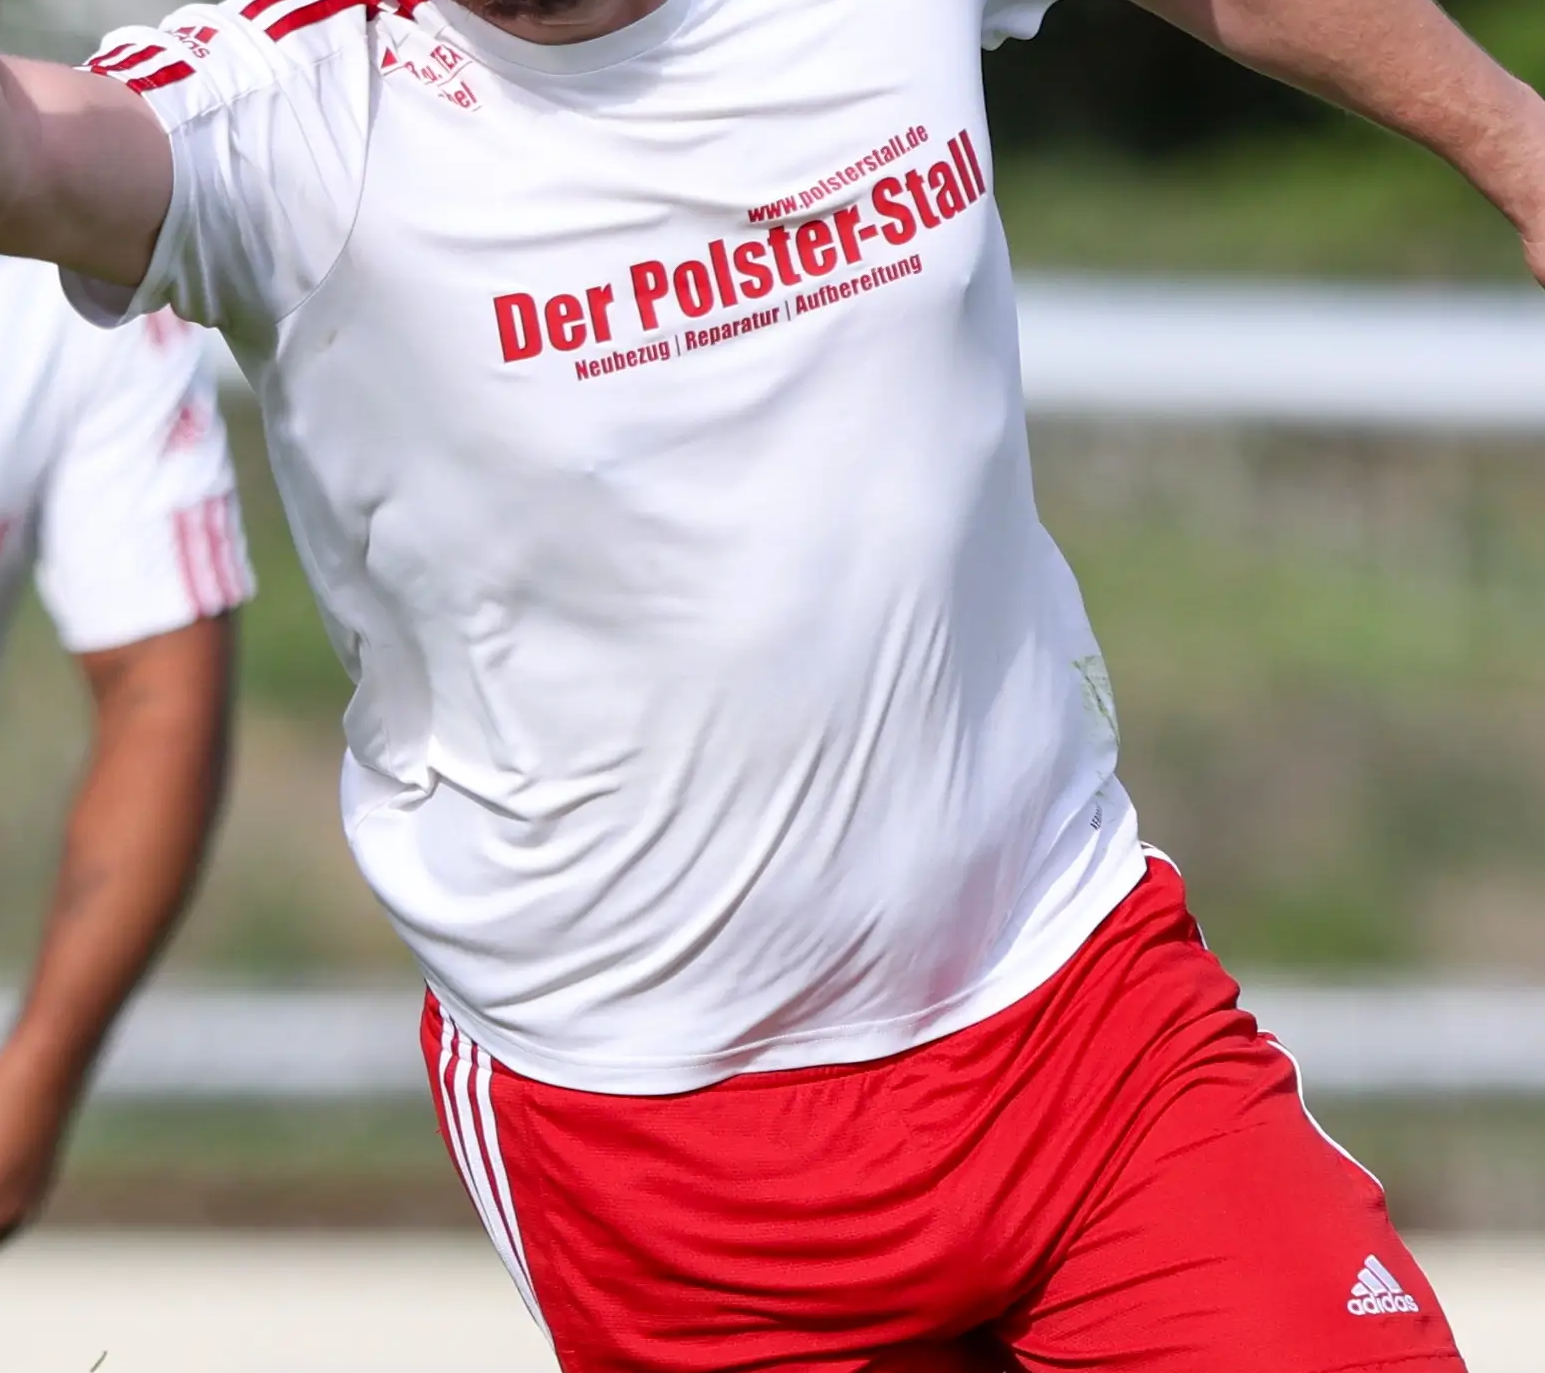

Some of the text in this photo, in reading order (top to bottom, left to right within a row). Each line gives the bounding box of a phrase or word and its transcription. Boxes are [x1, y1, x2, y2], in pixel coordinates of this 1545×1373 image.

[747, 124, 929, 223] www.polsterstall.de
[493, 129, 986, 362] Der Polster-Stall
[575, 254, 922, 380] Neubezug Reparatur Aufbereitung
[1347, 1293, 1419, 1315] adidas
